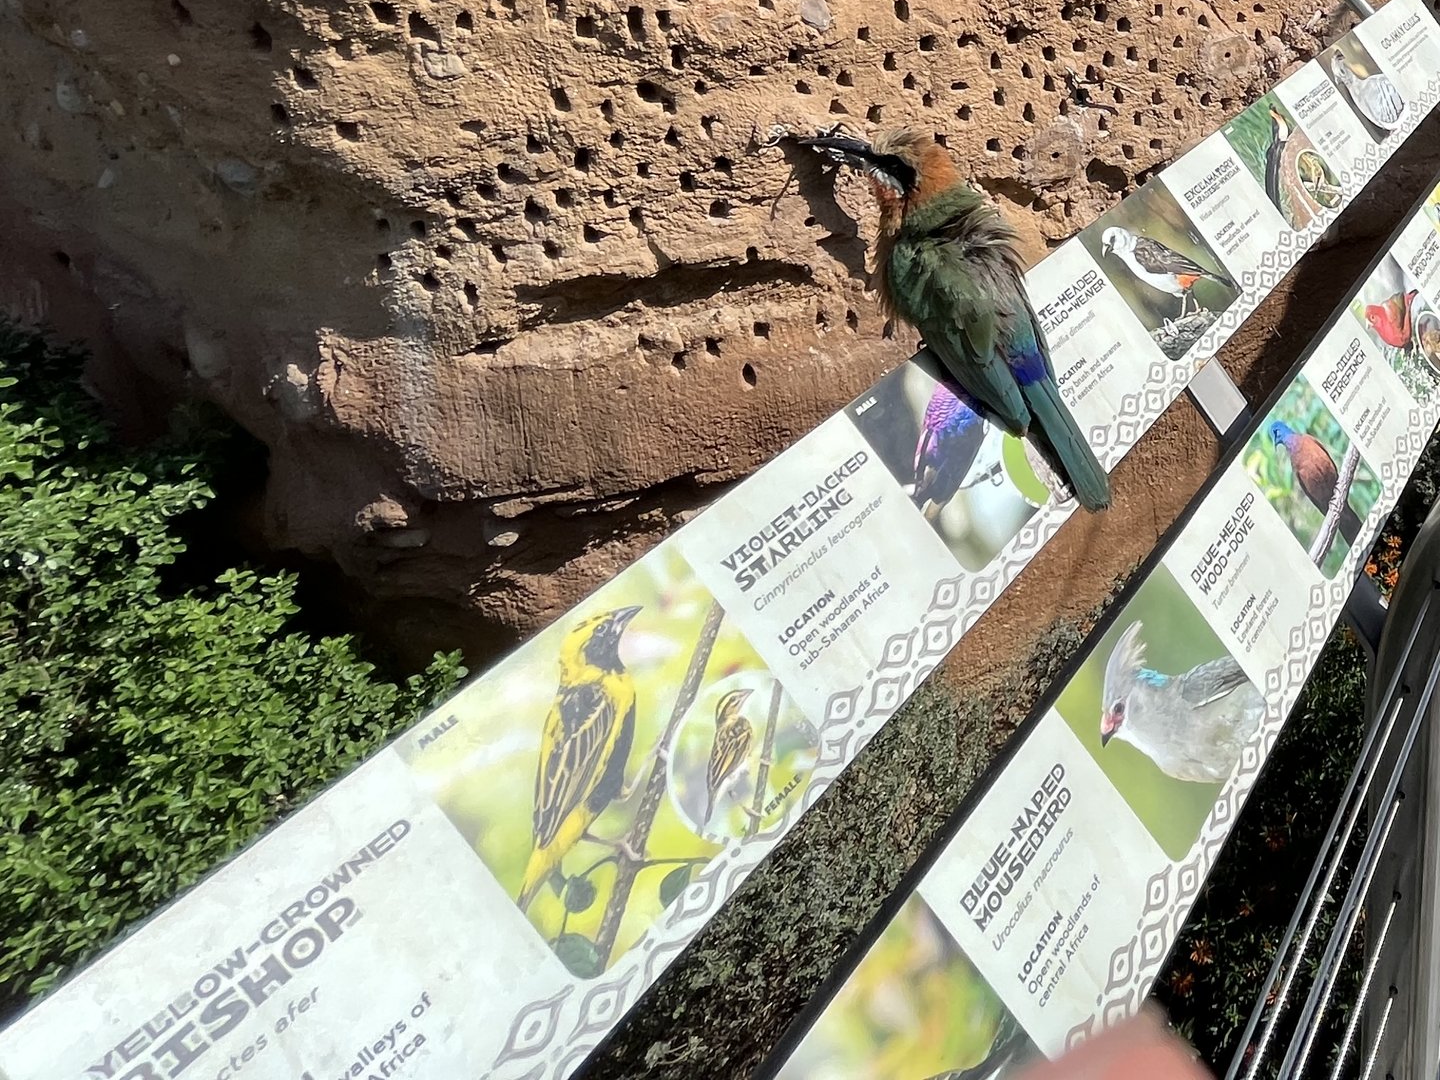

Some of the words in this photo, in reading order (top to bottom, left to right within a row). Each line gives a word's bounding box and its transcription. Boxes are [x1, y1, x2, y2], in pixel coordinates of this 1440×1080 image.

[1183, 156, 1235, 201] EXCLAMATORY
[1214, 220, 1235, 241] LOCATION
[1038, 270, 1098, 323] TE-HEADED
[1062, 386, 1075, 398] Dry
[1073, 370, 1090, 387] brush
[1070, 396, 1078, 407] of
[1077, 378, 1099, 400] eastern
[1096, 363, 1114, 381] Africa
[1329, 349, 1367, 404] FIREFINCH
[1353, 407, 1371, 434] LOCATION
[720, 450, 868, 572] VIOLET-BACKED
[733, 487, 854, 593] STARLING
[1190, 492, 1255, 584] BLUE-HEADED
[753, 545, 829, 612] Cinnyricinclus
[828, 494, 885, 547] leucogaster
[1198, 515, 1256, 596] WOOD-DOVE
[777, 589, 836, 645] LOCATION
[788, 627, 820, 657] Open
[819, 579, 871, 629] woodlands
[870, 565, 883, 580] of
[799, 607, 863, 671] sub-Saharan
[862, 580, 890, 610] Africa
[1230, 593, 1257, 635] LOCATION
[1237, 612, 1259, 644] Lowland
[1256, 588, 1273, 613] forests
[1245, 641, 1252, 653] of
[1251, 617, 1267, 643] central
[1265, 597, 1279, 619] Africa
[418, 714, 459, 750] MALE
[764, 774, 802, 816] FEMALE
[959, 763, 1065, 915] BLUE-NAPED
[972, 787, 1073, 933] MOUSEBIRD
[992, 890, 1033, 952] Urocolius
[1033, 827, 1074, 892] macrourus
[83, 819, 412, 1079] YELLOW-CROWNED
[1018, 910, 1064, 984] LOCATION
[1028, 957, 1053, 995] Open
[1051, 890, 1093, 957] woodlands
[1091, 873, 1101, 892] of
[1038, 958, 1067, 1008] central
[1066, 923, 1090, 963] Africa
[216, 1034, 268, 1080] ctes
[274, 986, 320, 1034] afer
[411, 991, 432, 1019] of
